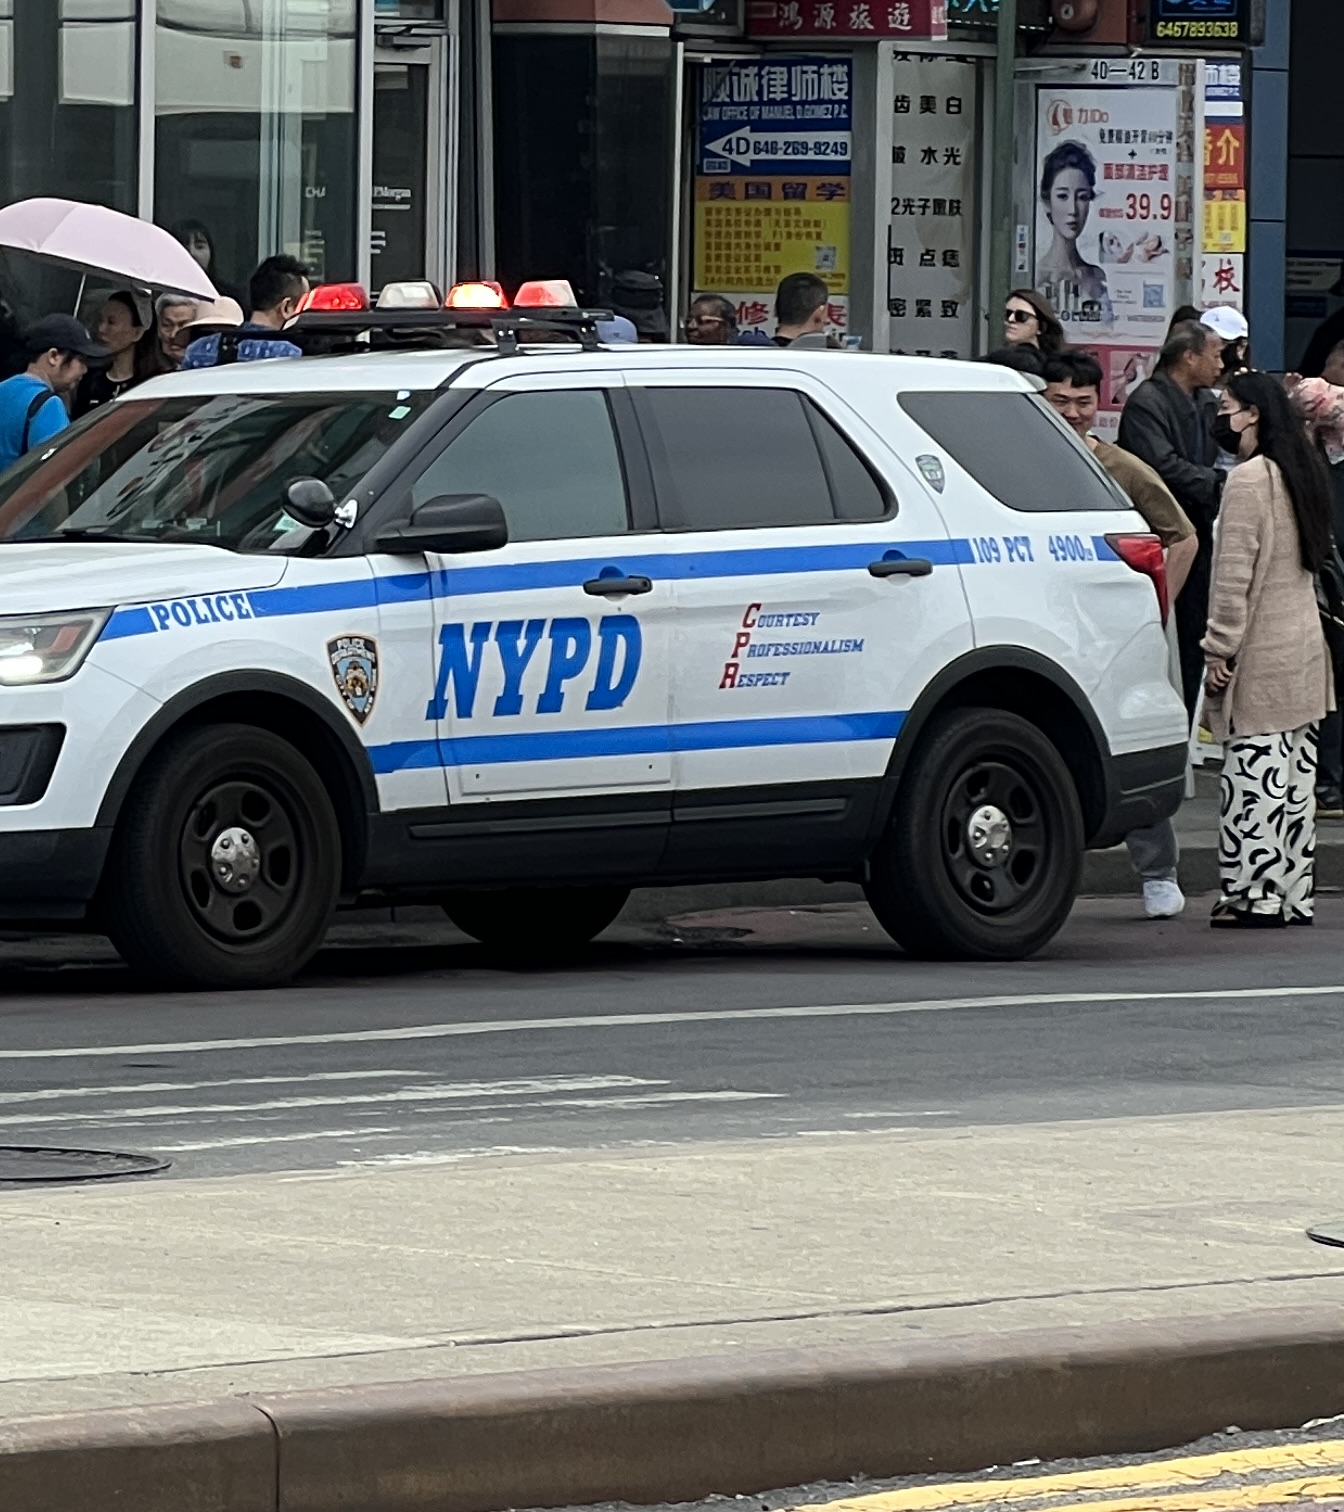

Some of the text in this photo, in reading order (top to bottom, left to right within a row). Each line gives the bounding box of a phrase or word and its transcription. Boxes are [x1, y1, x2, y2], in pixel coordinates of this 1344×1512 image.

[1151, 61, 1159, 80] B
[722, 137, 750, 155] 4D
[1125, 192, 1172, 220] 39.9
[972, 534, 1085, 563] 109 PCT 4900
[152, 592, 253, 632] POLICE
[742, 603, 821, 629] COURTESY
[731, 633, 865, 660] PROFESSIONALISM
[425, 614, 641, 721] NYPD
[718, 662, 791, 690] RESPECT
